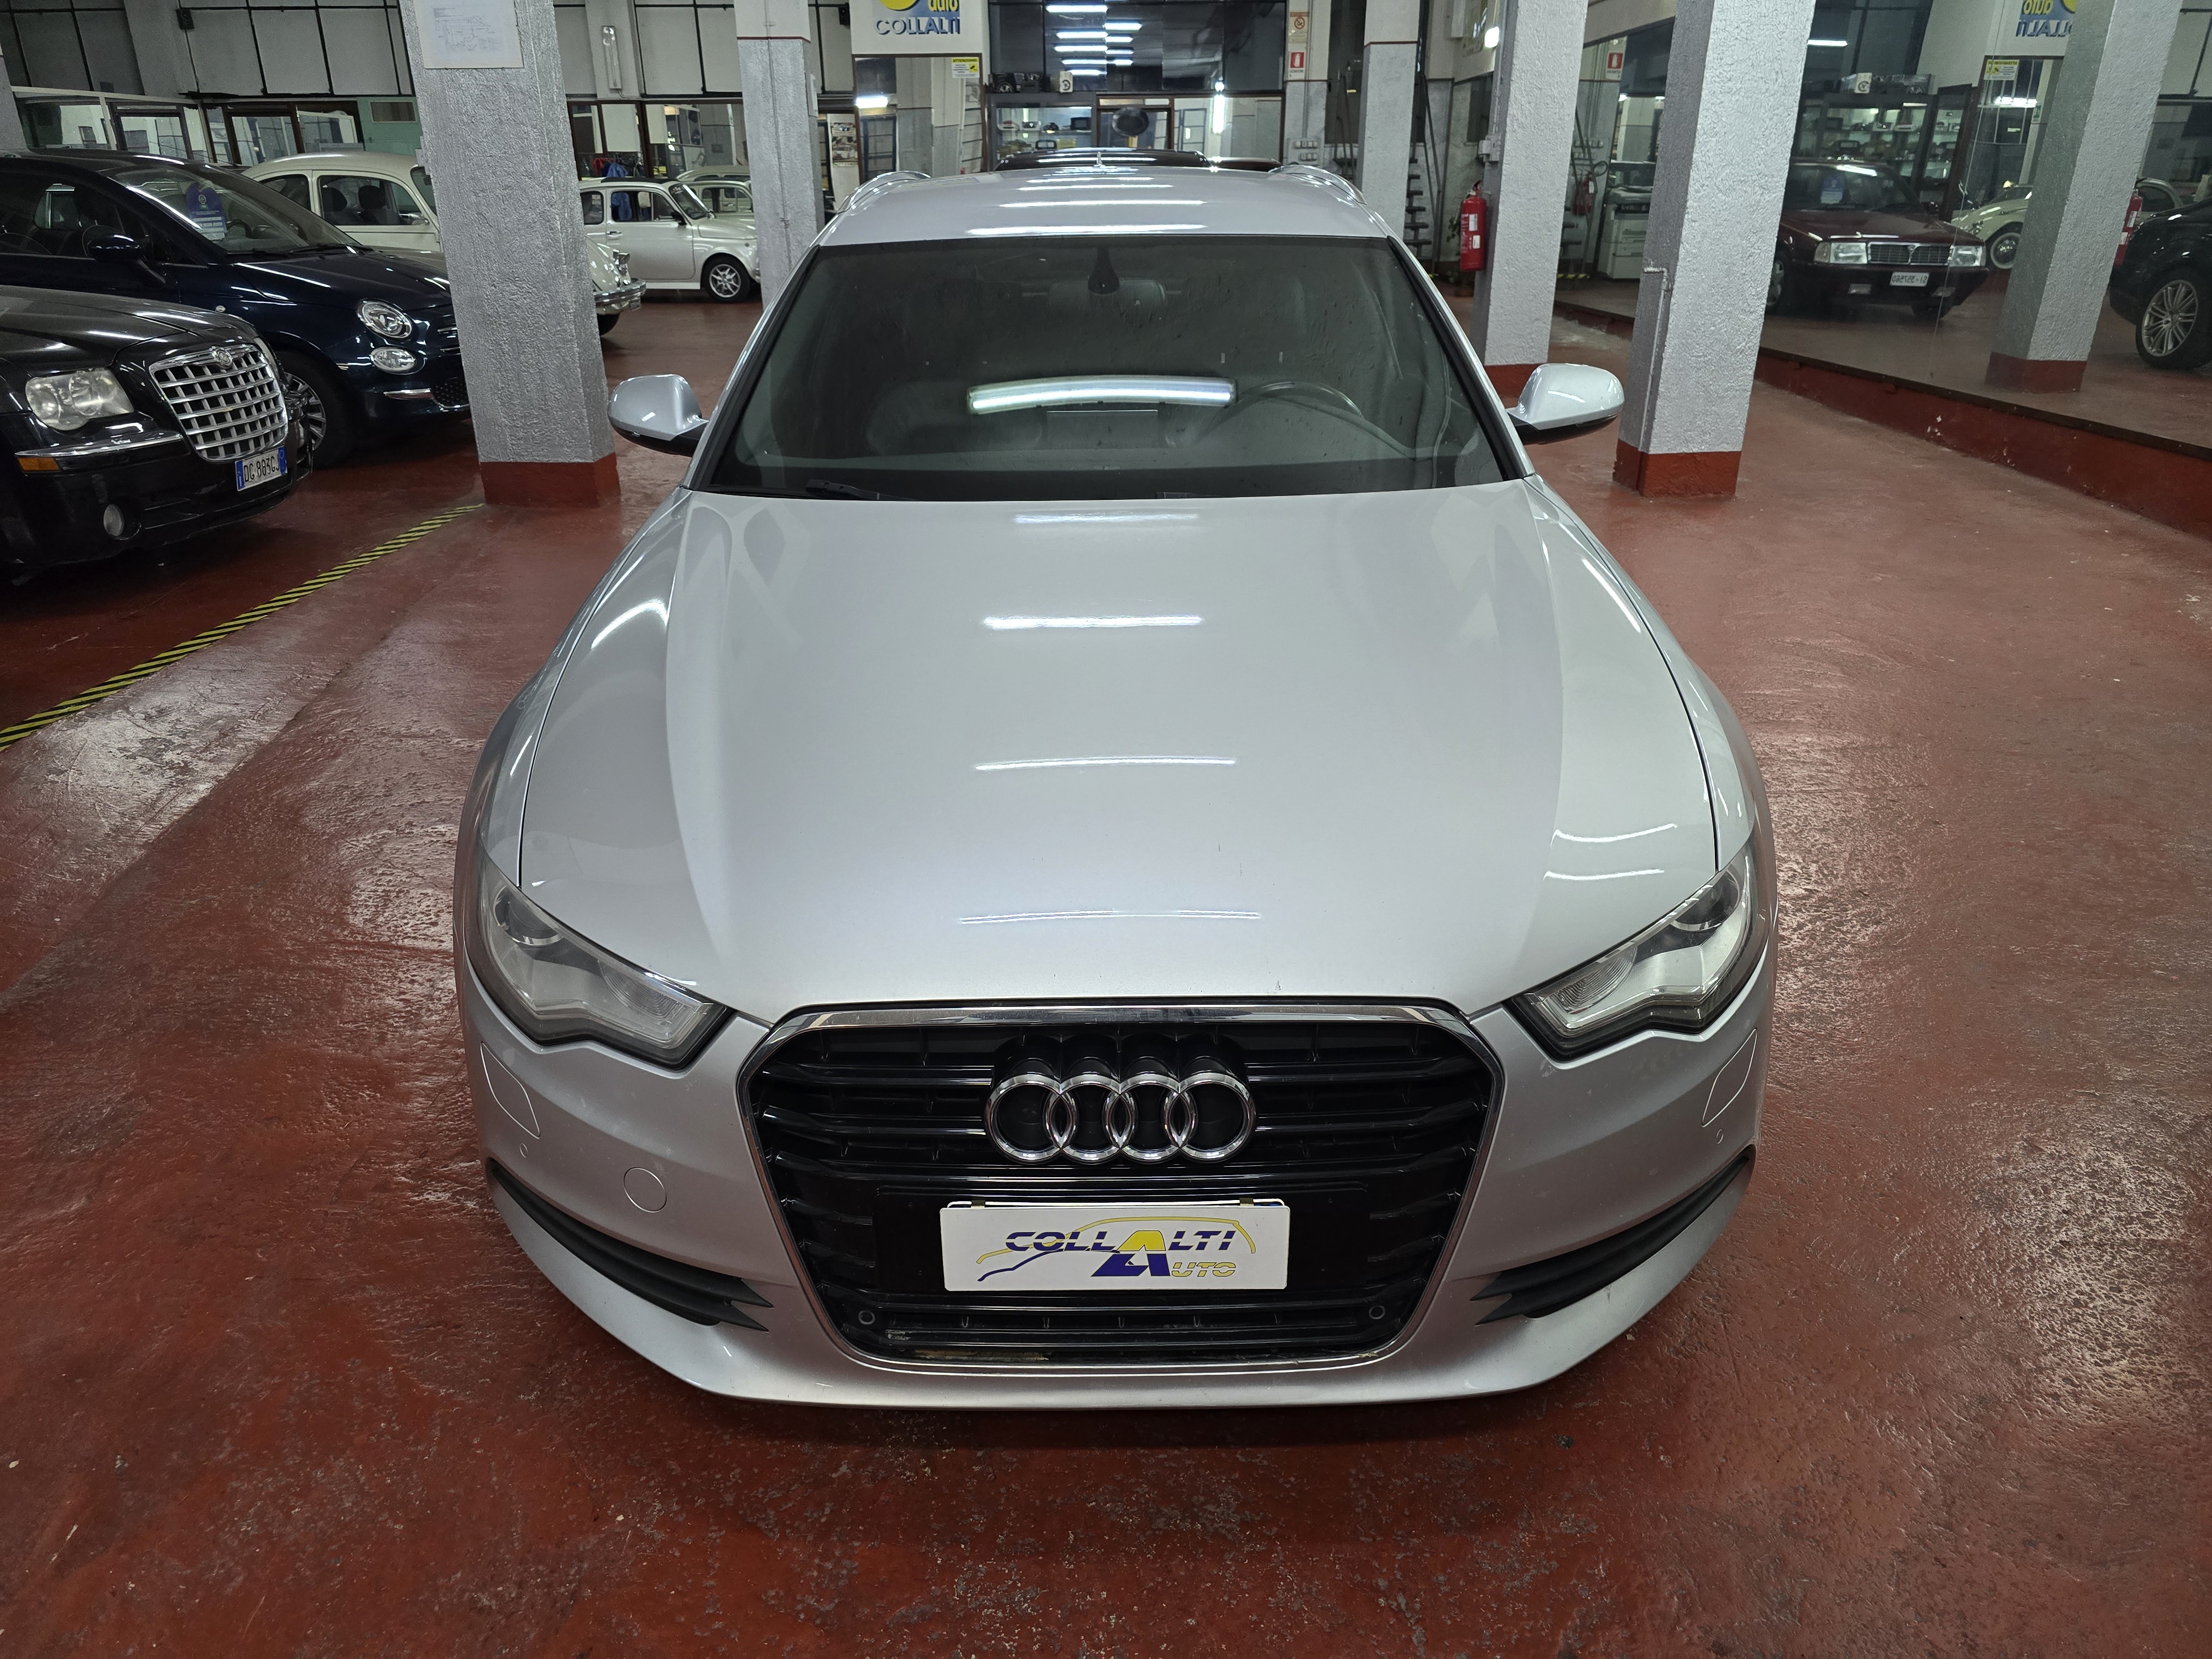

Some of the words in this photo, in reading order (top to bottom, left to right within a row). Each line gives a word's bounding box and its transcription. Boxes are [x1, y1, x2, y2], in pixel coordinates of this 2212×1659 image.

[877, 17, 960, 35] COLLALTI
[244, 463, 254, 482] DG
[256, 453, 279, 477] 883GJ
[1005, 1230, 1237, 1277] COLLALTI
